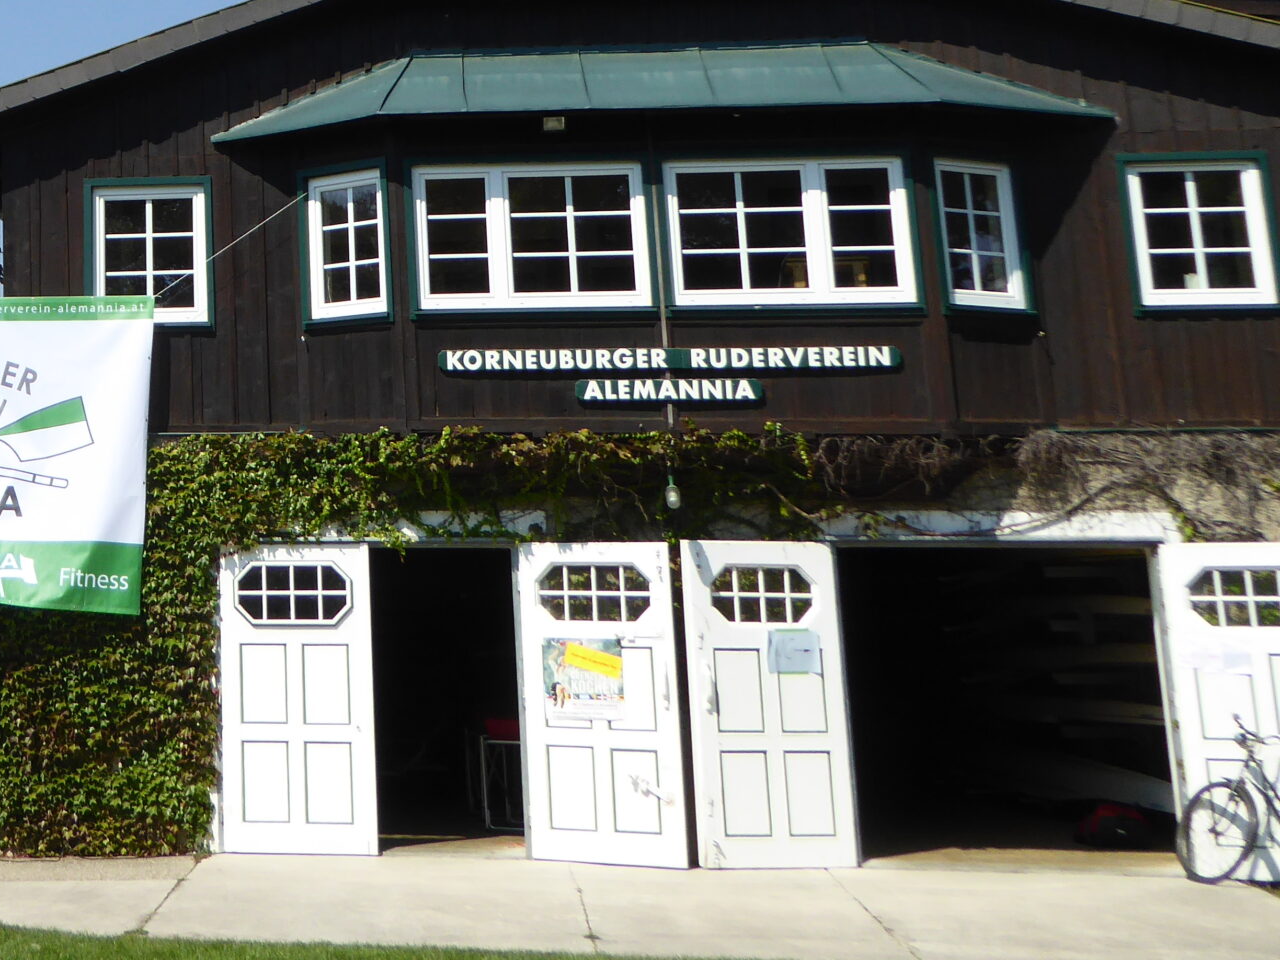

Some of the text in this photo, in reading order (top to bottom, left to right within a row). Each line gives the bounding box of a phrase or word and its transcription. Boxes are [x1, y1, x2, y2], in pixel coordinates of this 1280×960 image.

[446, 346, 892, 371] KORNEUBURGER RUDERVEREIN
[583, 379, 757, 400] ALEMANNIA
[58, 567, 129, 591] Fitness
